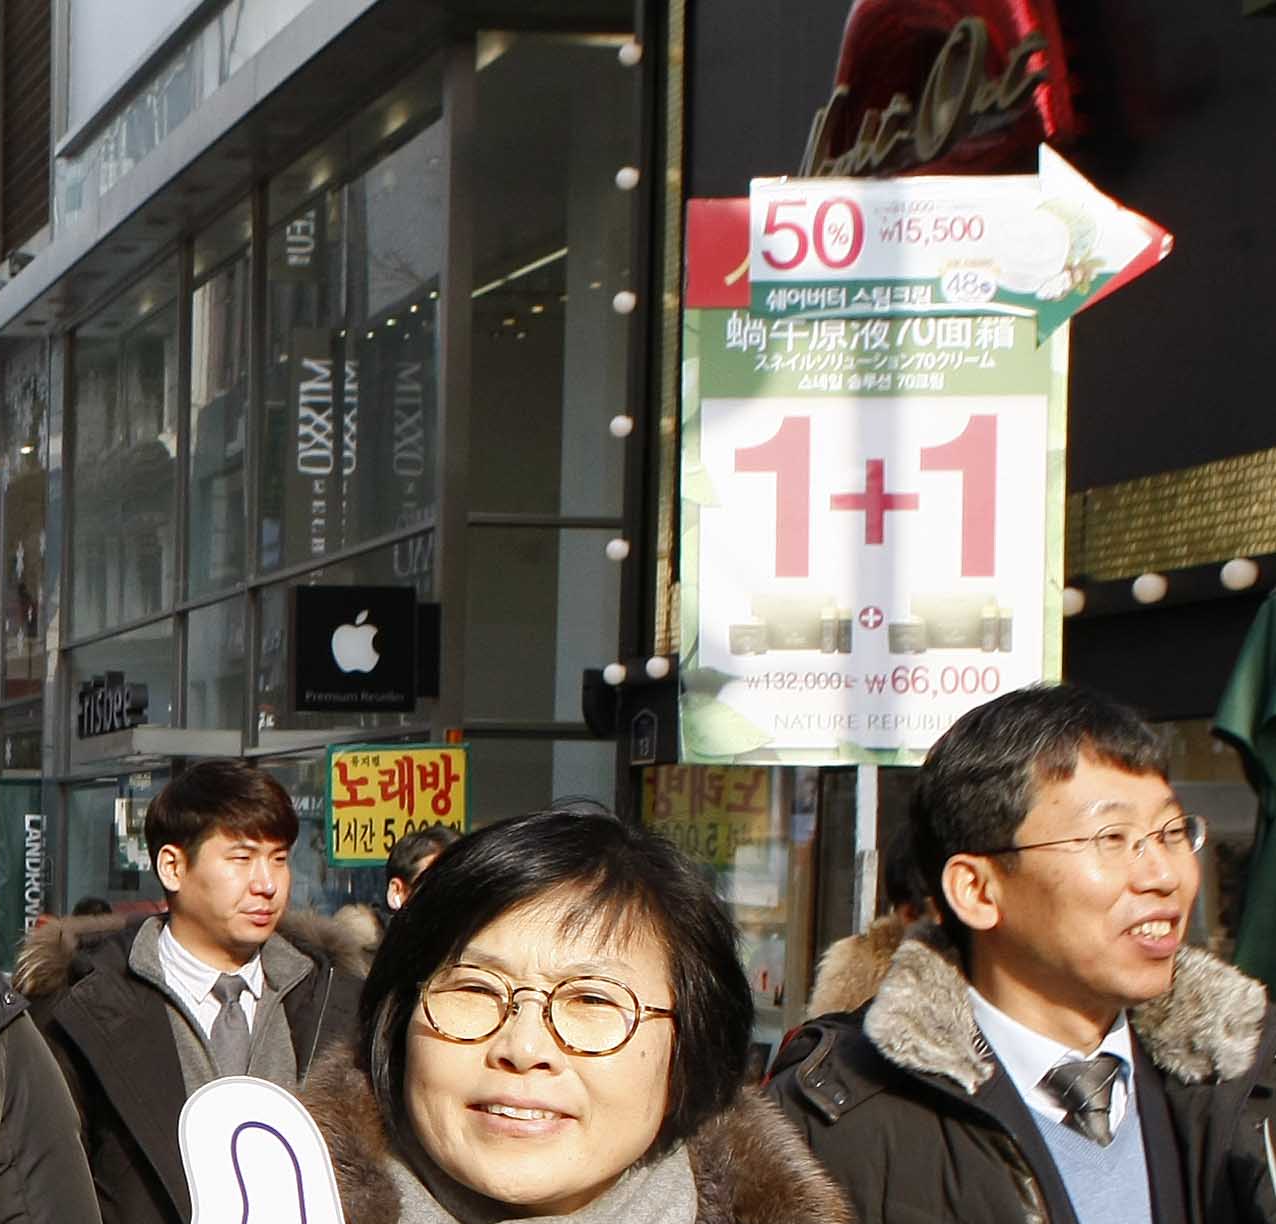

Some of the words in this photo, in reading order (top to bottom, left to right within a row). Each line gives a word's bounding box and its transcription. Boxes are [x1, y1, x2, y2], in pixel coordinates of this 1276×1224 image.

[734, 413, 998, 578] 1+1
[773, 713, 857, 730] NATURE
[332, 752, 461, 817] 노래방
[332, 818, 376, 854] 1시간
[24, 814, 42, 934] LANDROVE
